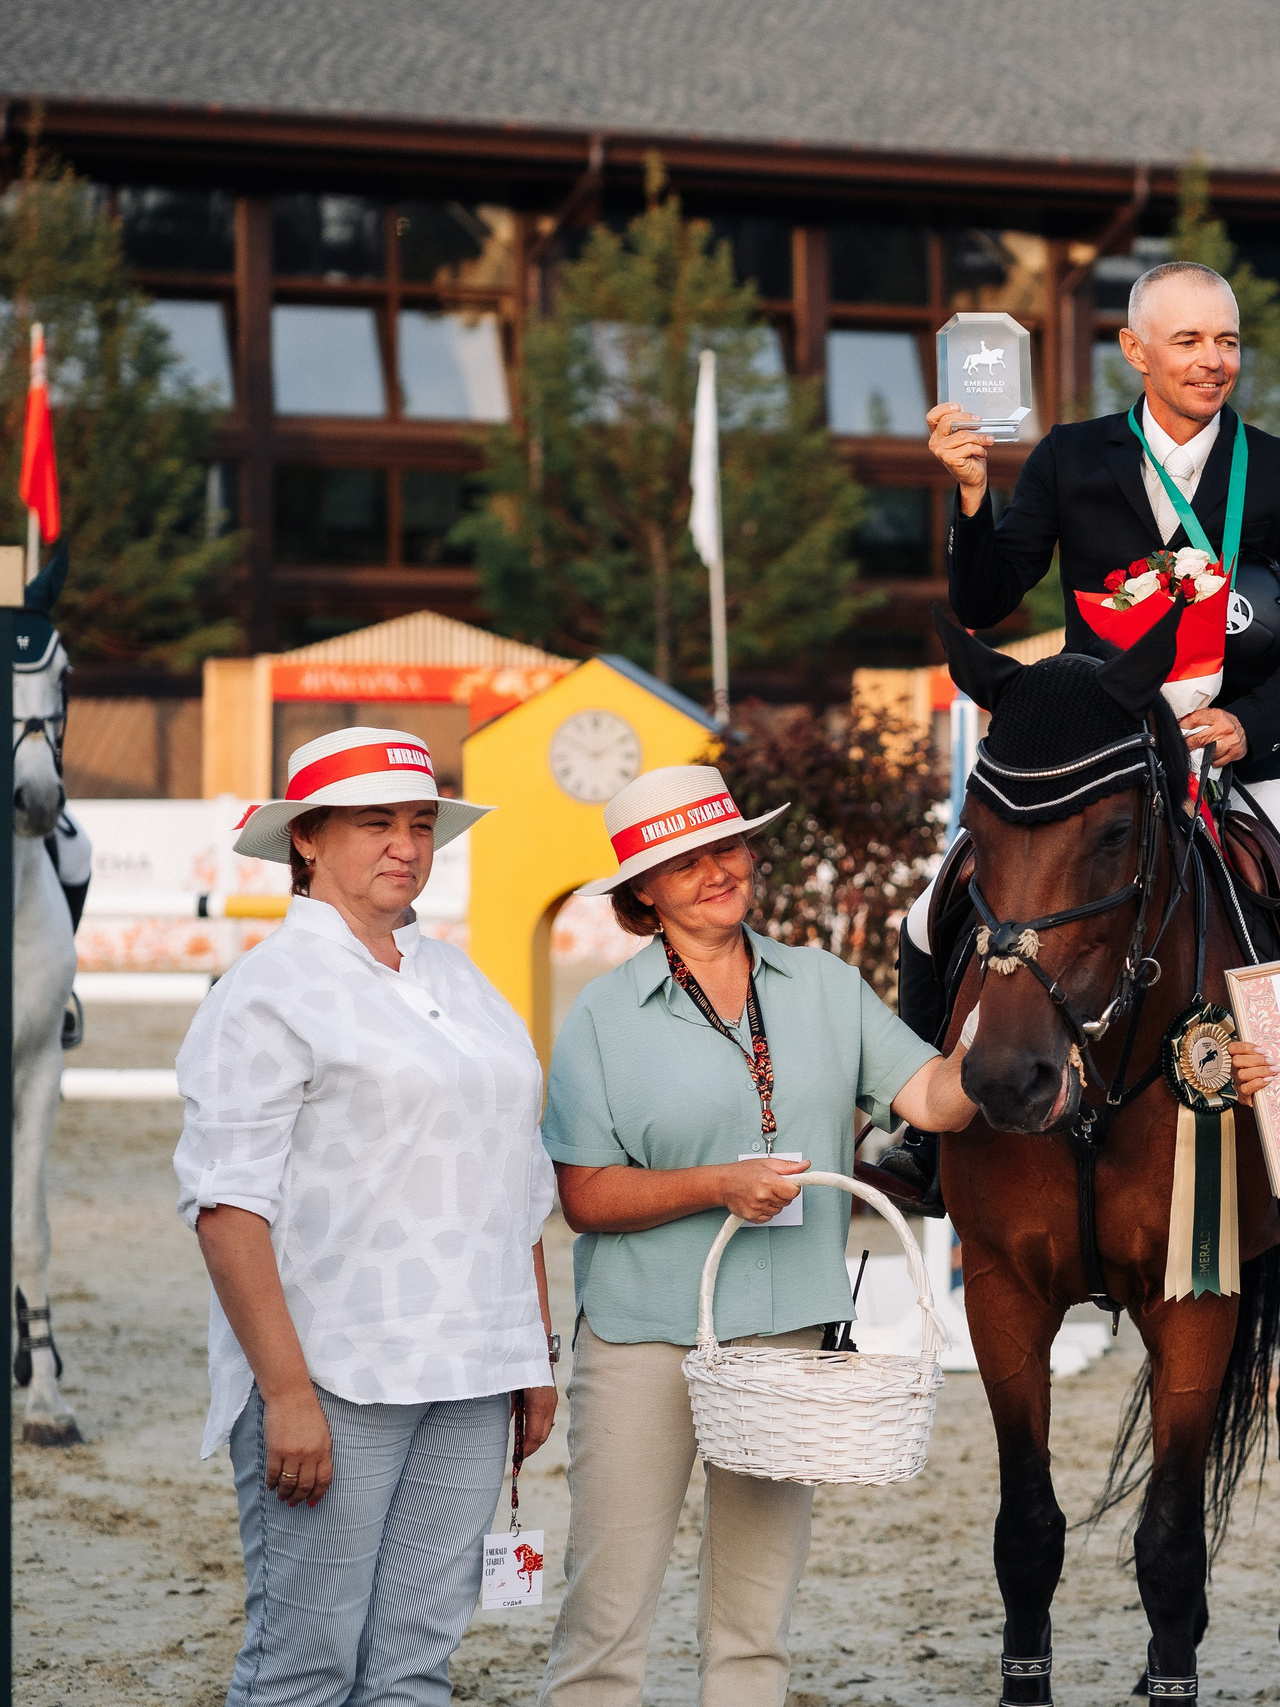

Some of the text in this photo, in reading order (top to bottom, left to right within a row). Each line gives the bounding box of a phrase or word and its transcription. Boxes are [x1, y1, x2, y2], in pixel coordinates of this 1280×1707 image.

[386, 748, 426, 767] EMERALD
[641, 813, 686, 843] EMERALD
[687, 800, 725, 826] STABLES
[1200, 1231, 1211, 1277] EMERALD
[486, 1547, 507, 1556] EMERALD
[486, 1557, 505, 1566] STABLES
